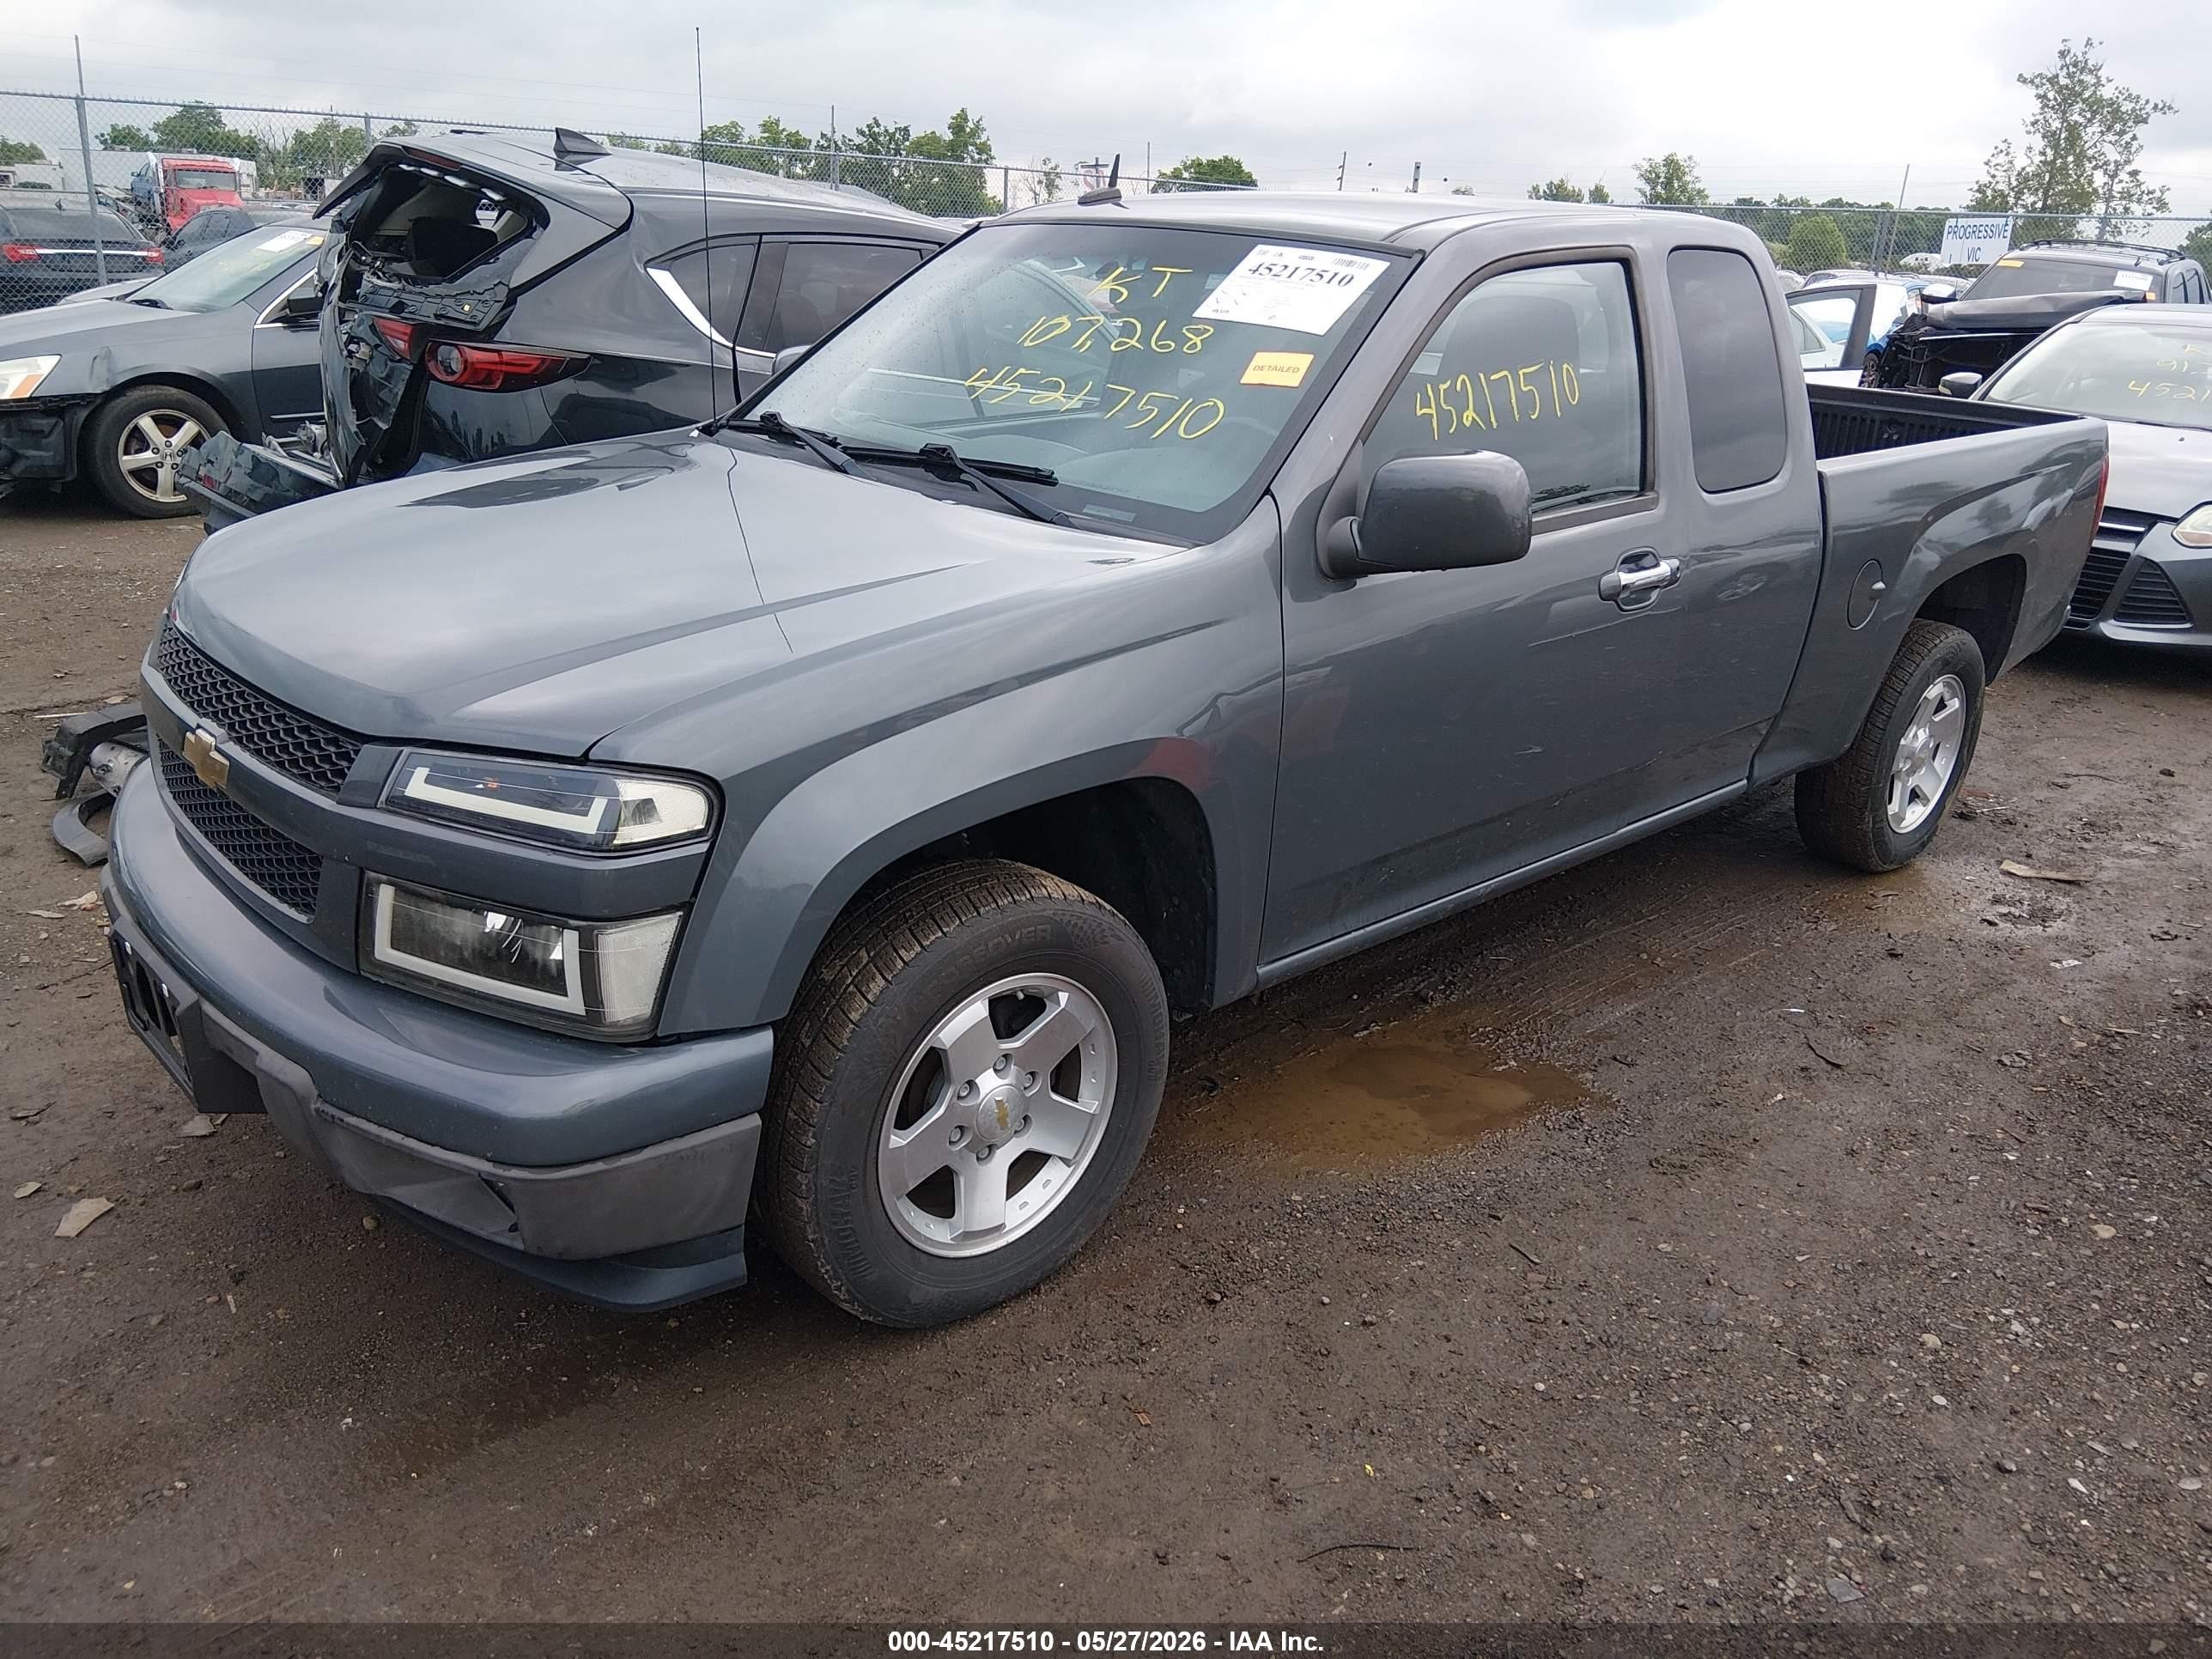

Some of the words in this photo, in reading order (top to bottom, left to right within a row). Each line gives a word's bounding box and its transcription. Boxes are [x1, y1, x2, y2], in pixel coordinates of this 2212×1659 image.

[1947, 224, 2008, 240] PROGRESSIVE
[1967, 247, 1982, 262] VIC
[1249, 262, 1355, 287] 45217510
[1252, 364, 1301, 374] DETAILED
[964, 366, 1225, 440] 45217510
[1415, 359, 1580, 441] 45217510
